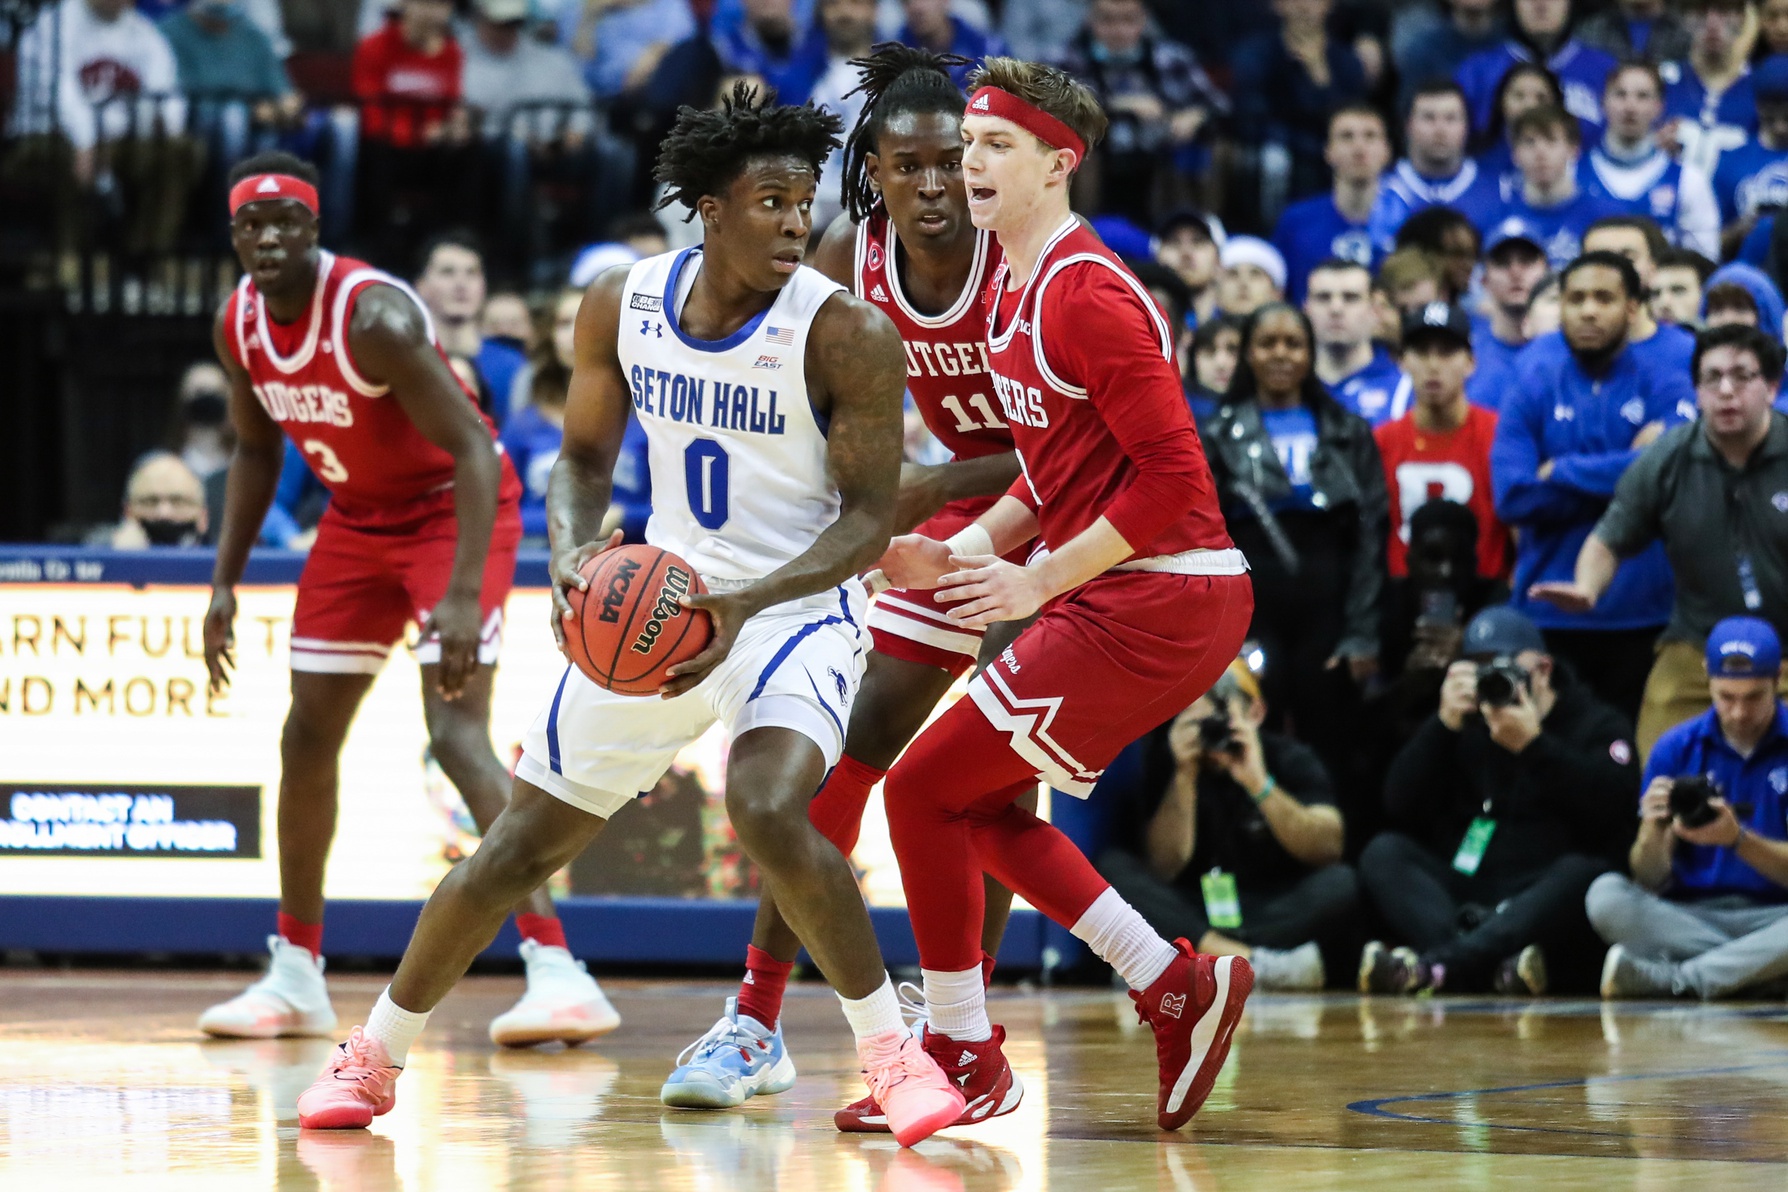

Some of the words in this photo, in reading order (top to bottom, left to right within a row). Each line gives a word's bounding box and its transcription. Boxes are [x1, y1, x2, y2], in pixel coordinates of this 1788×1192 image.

[753, 360, 784, 370] EAST
[757, 354, 780, 363] BIG
[631, 364, 706, 426] SETON
[710, 380, 786, 436] HALL
[940, 392, 1011, 434] 11
[303, 439, 349, 483] 3
[683, 435, 732, 533] 0
[598, 558, 642, 624] NCAA
[630, 564, 691, 655] Wilson
[0, 614, 87, 657] RN
[105, 613, 238, 658] FUL
[1159, 992, 1187, 1019] R
